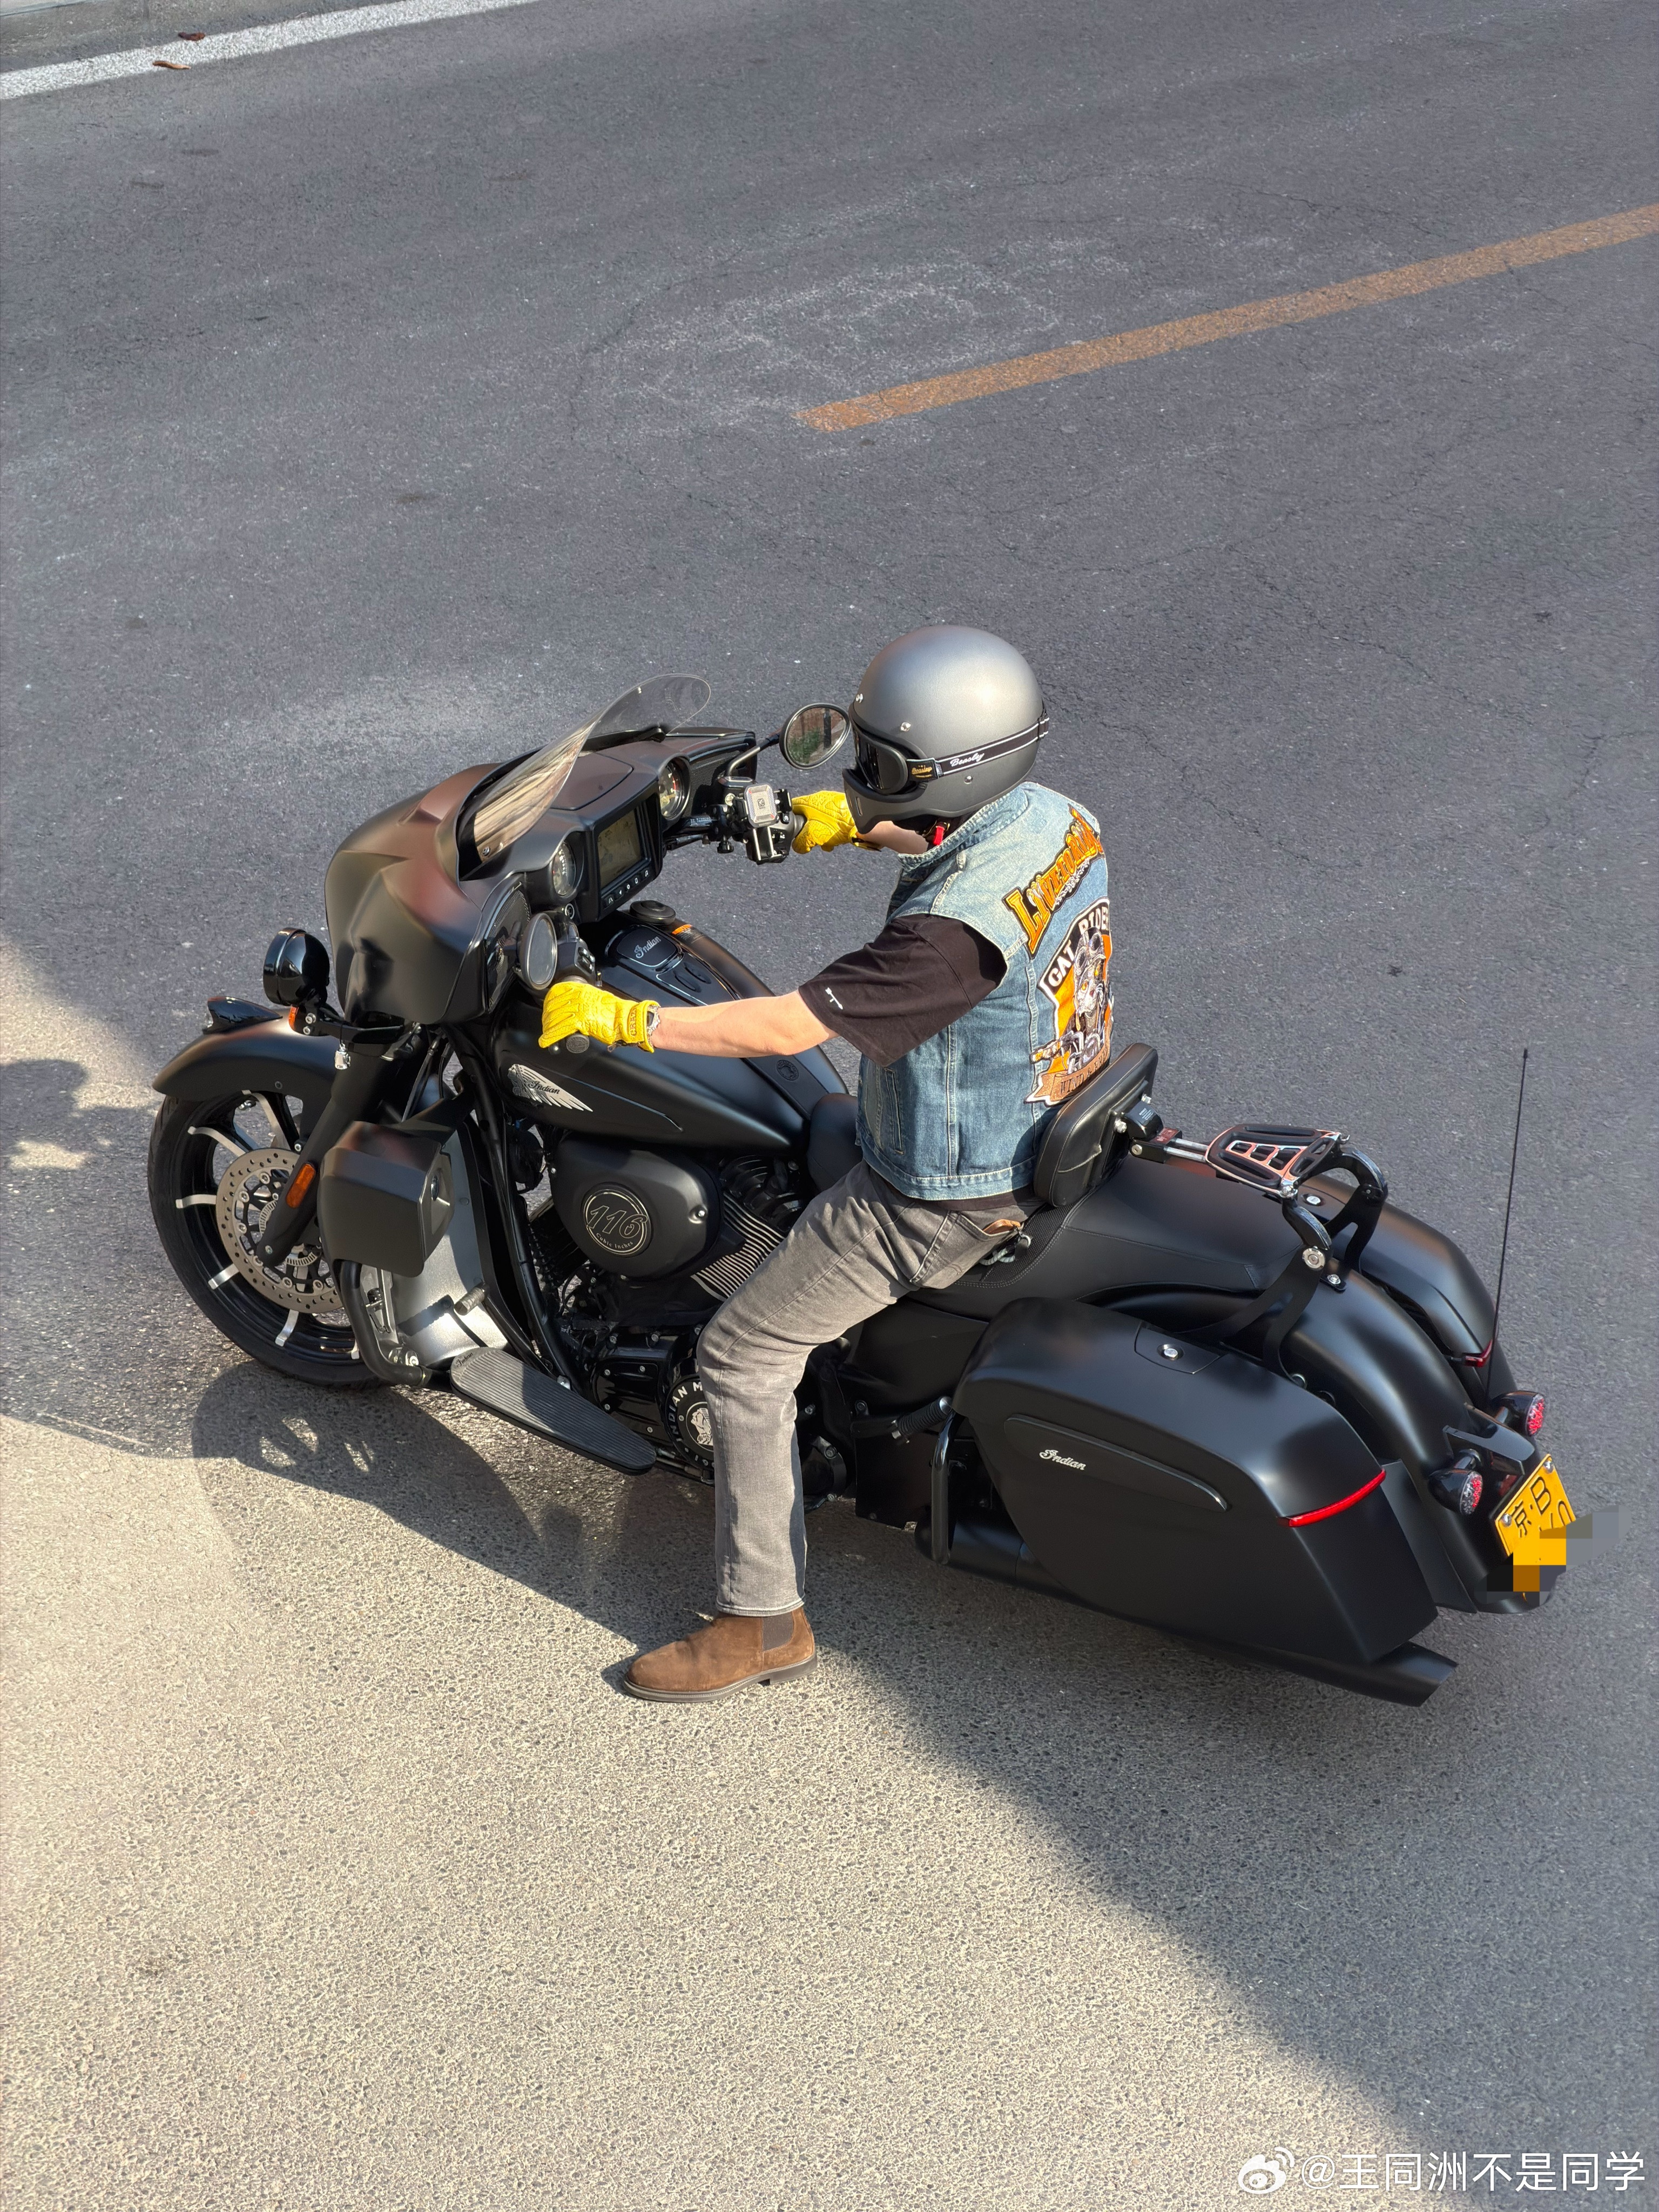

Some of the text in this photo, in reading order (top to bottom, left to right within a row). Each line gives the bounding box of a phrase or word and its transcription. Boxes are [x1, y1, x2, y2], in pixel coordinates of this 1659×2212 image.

[950, 753, 984, 767] Beasley
[634, 936, 662, 959] Indian
[1048, 939, 1075, 987] CAT
[528, 1081, 560, 1095] Indian
[586, 1205, 648, 1239] 116
[596, 1232, 633, 1249] Cubic Inches
[668, 1386, 688, 1442] INDIAN
[1039, 1449, 1086, 1471] Indian
